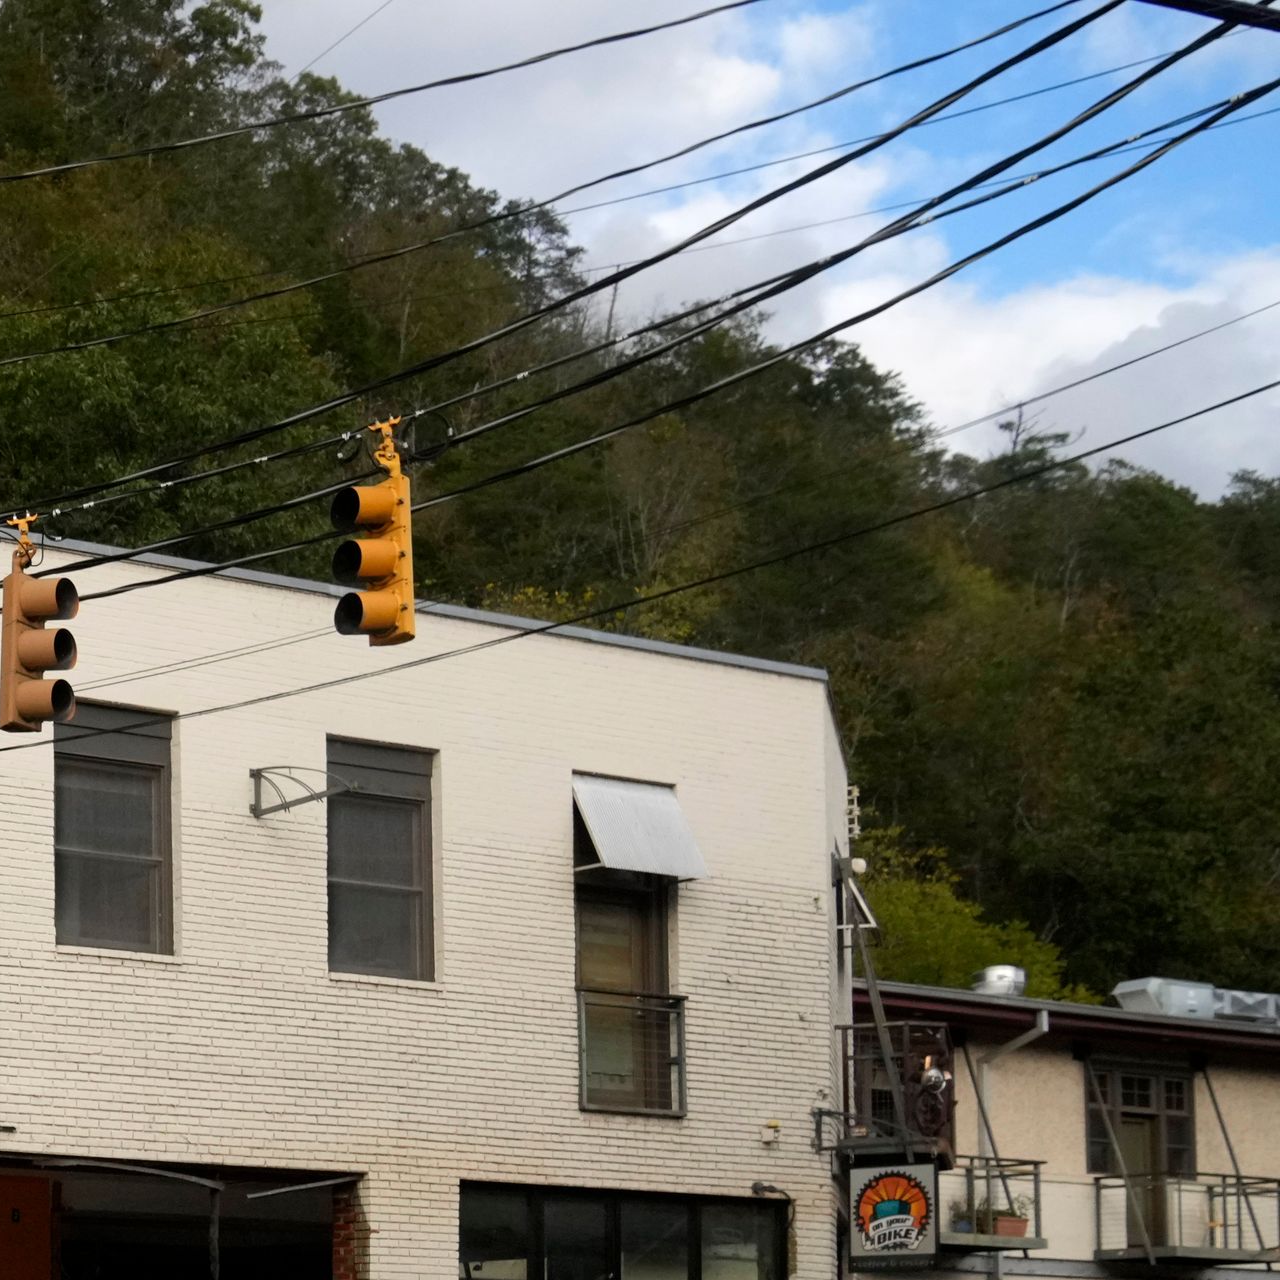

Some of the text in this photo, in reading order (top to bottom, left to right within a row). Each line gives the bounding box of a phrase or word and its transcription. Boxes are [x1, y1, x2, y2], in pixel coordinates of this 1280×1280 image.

[872, 1217, 910, 1232] on your
[877, 1228, 915, 1245] BIKE
